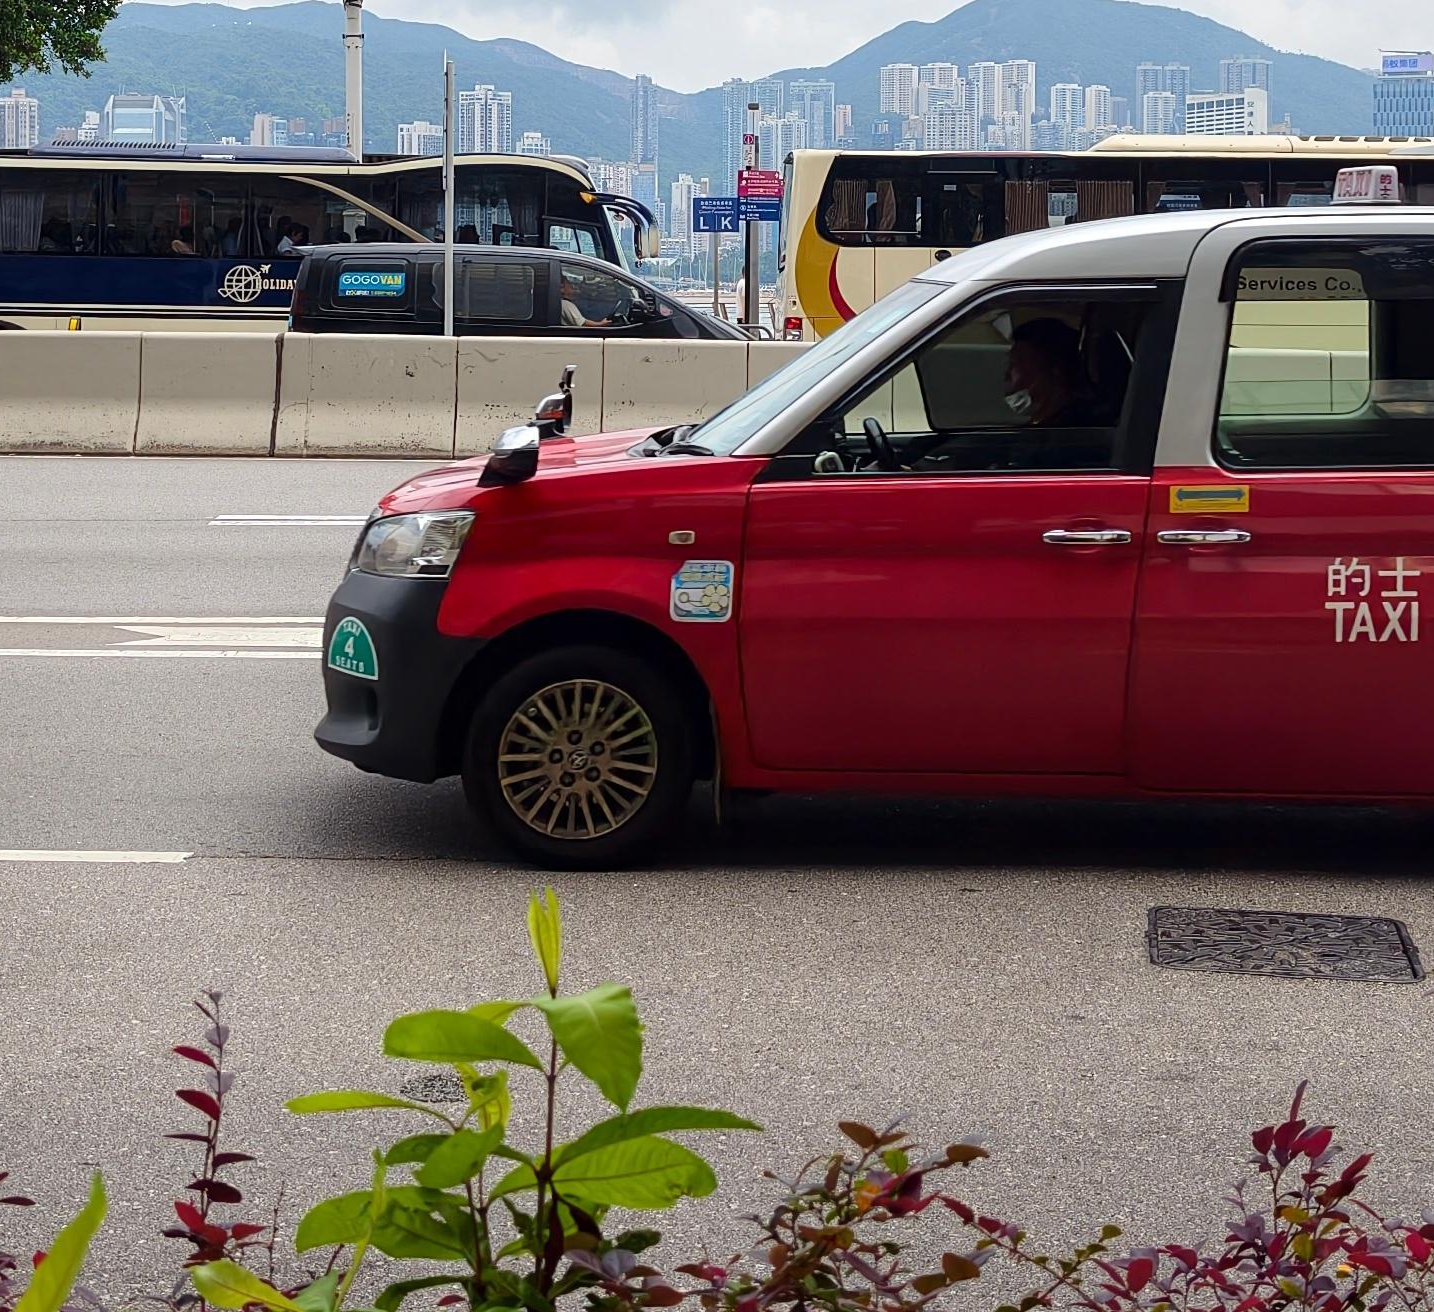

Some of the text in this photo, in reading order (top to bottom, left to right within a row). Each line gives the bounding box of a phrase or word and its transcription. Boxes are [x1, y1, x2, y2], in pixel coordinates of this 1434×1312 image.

[1380, 174, 1393, 199] 的士
[700, 216, 710, 230] L
[721, 216, 733, 230] K
[342, 275, 402, 285] GOGOVAN
[1238, 276, 1317, 291] Services
[1327, 556, 1421, 597] 的士
[1325, 601, 1419, 643] TAXI
[344, 636, 355, 658] 4
